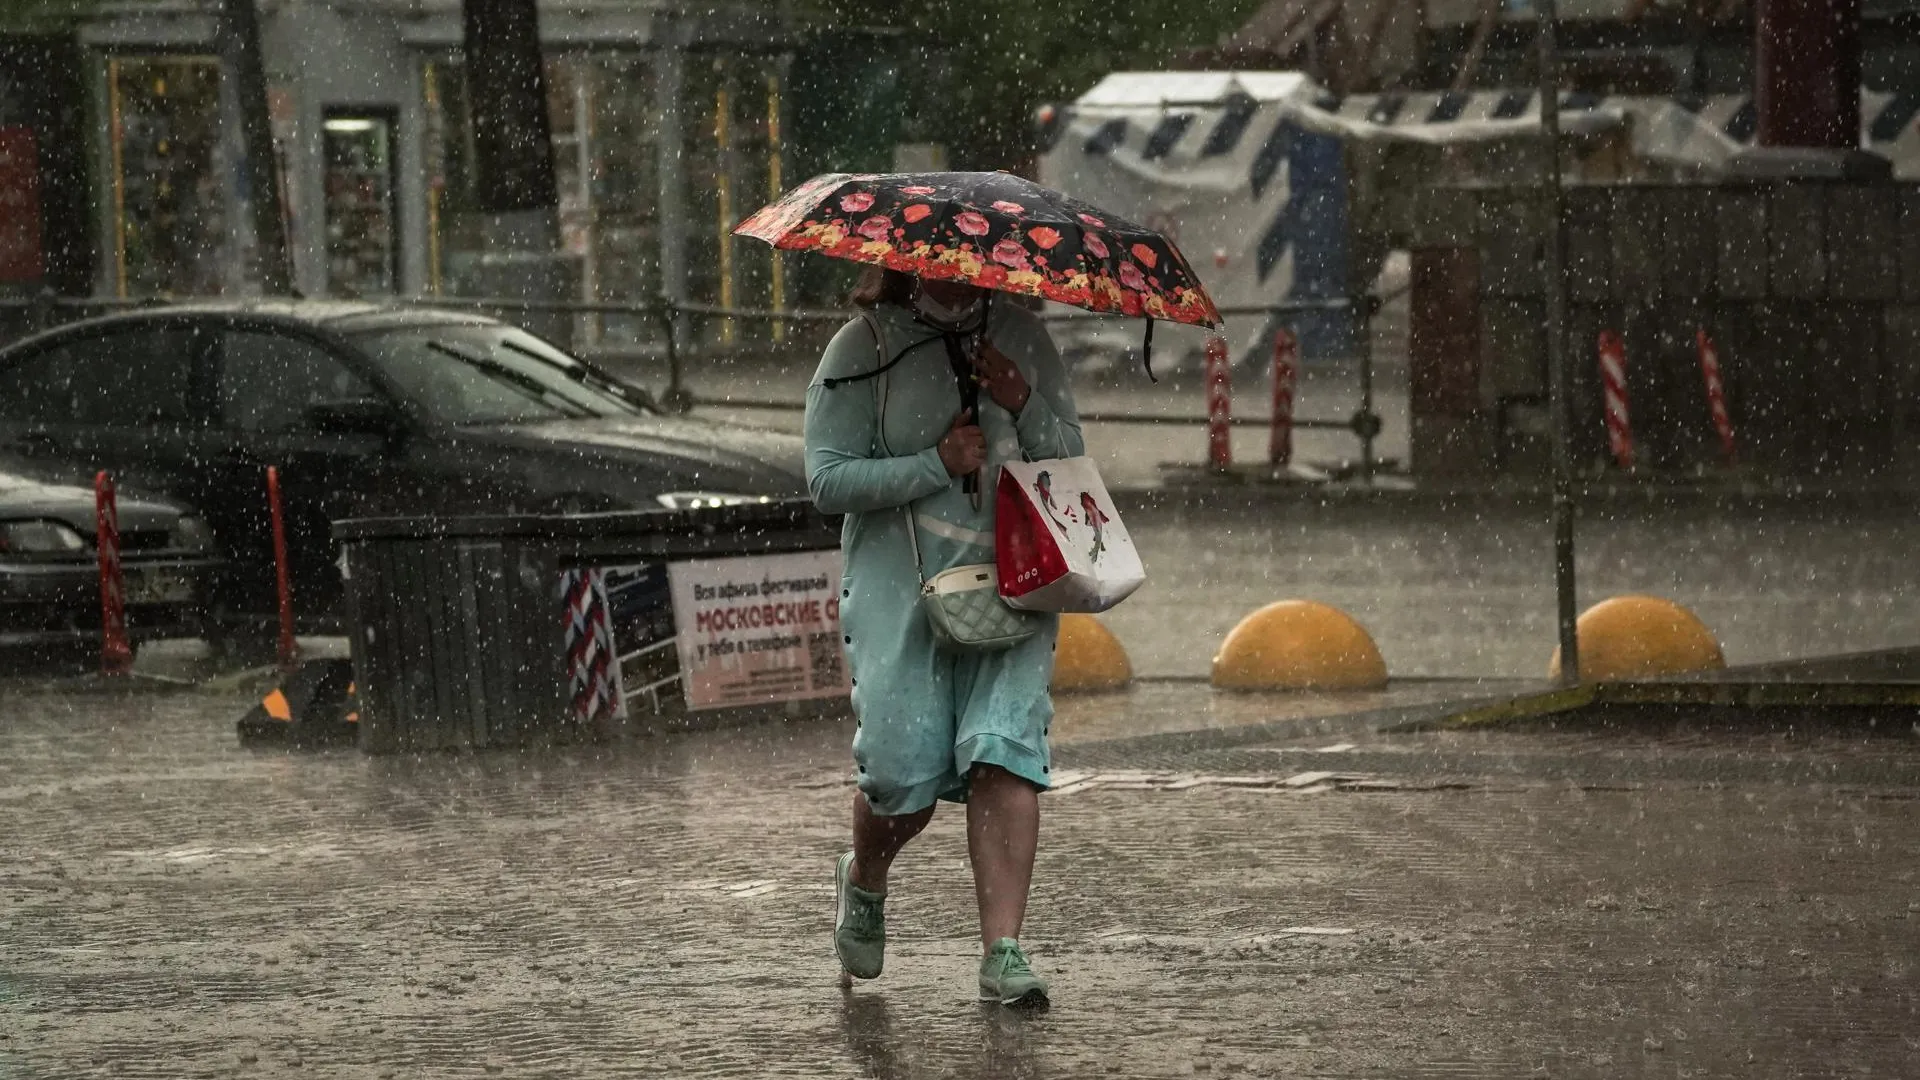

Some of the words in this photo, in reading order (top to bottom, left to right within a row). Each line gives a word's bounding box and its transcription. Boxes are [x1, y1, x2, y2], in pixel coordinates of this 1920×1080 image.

[695, 584, 715, 601] Вся
[718, 580, 758, 602] афиша
[760, 573, 828, 596] фестивалей
[696, 600, 821, 633] МОСКОВСКИЕ
[747, 634, 802, 651] телефоне
